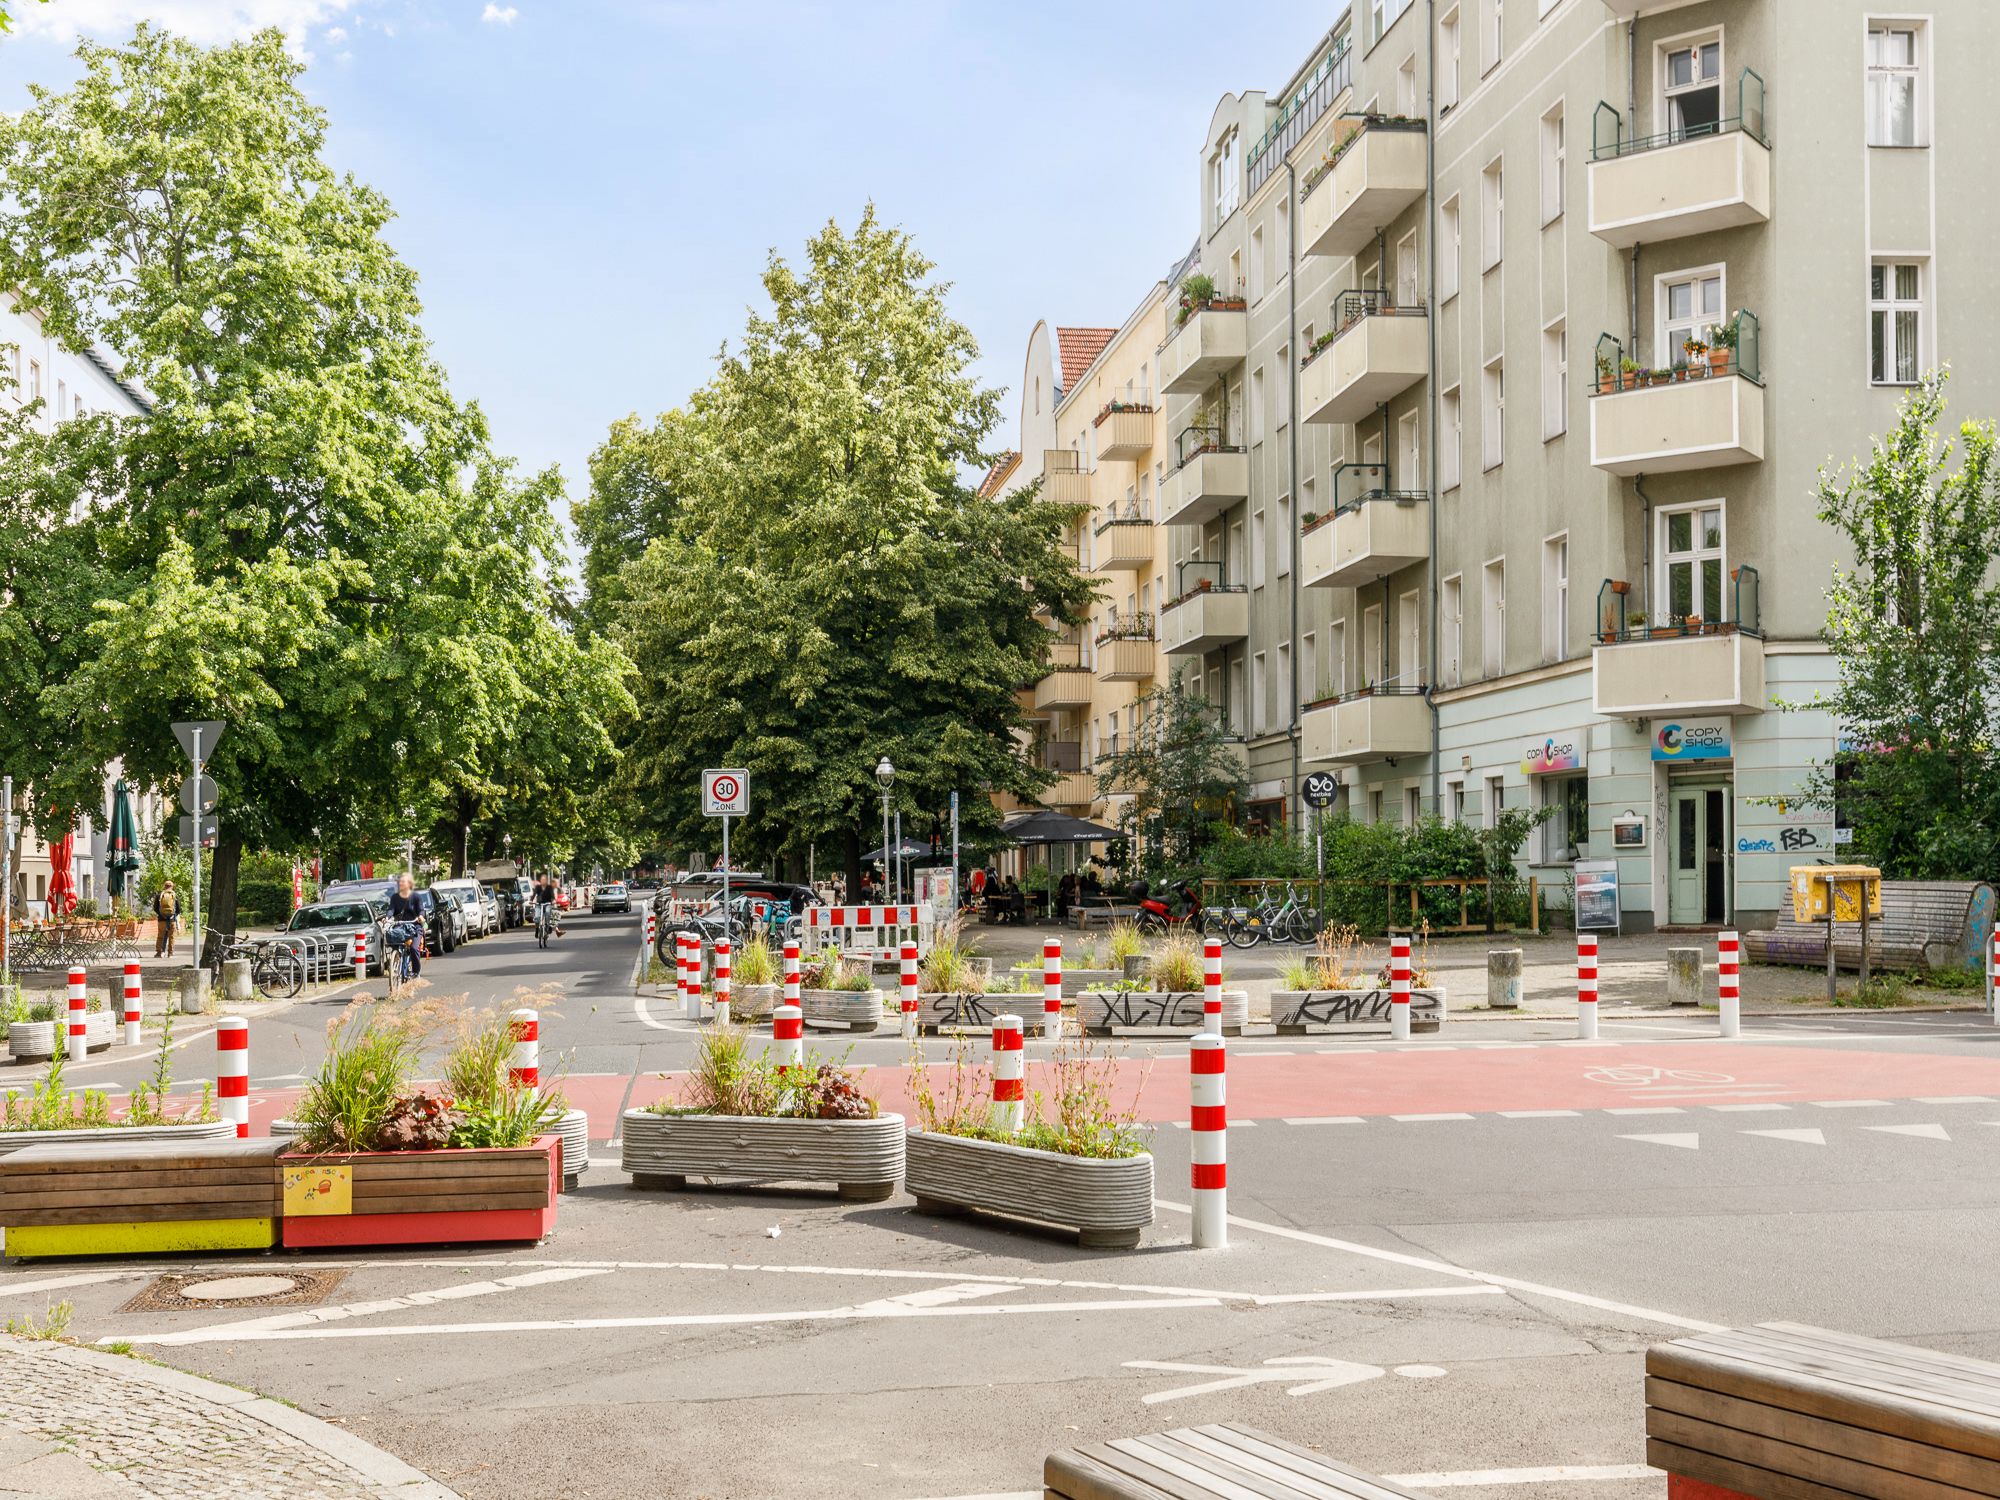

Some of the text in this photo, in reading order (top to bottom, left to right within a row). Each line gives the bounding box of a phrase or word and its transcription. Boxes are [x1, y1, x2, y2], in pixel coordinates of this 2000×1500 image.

[1686, 727, 1723, 738] COPY
[1685, 737, 1723, 747] SHOP
[1527, 744, 1573, 760] COPY SHOP
[717, 782, 734, 795] 30
[715, 803, 737, 811] ZONE
